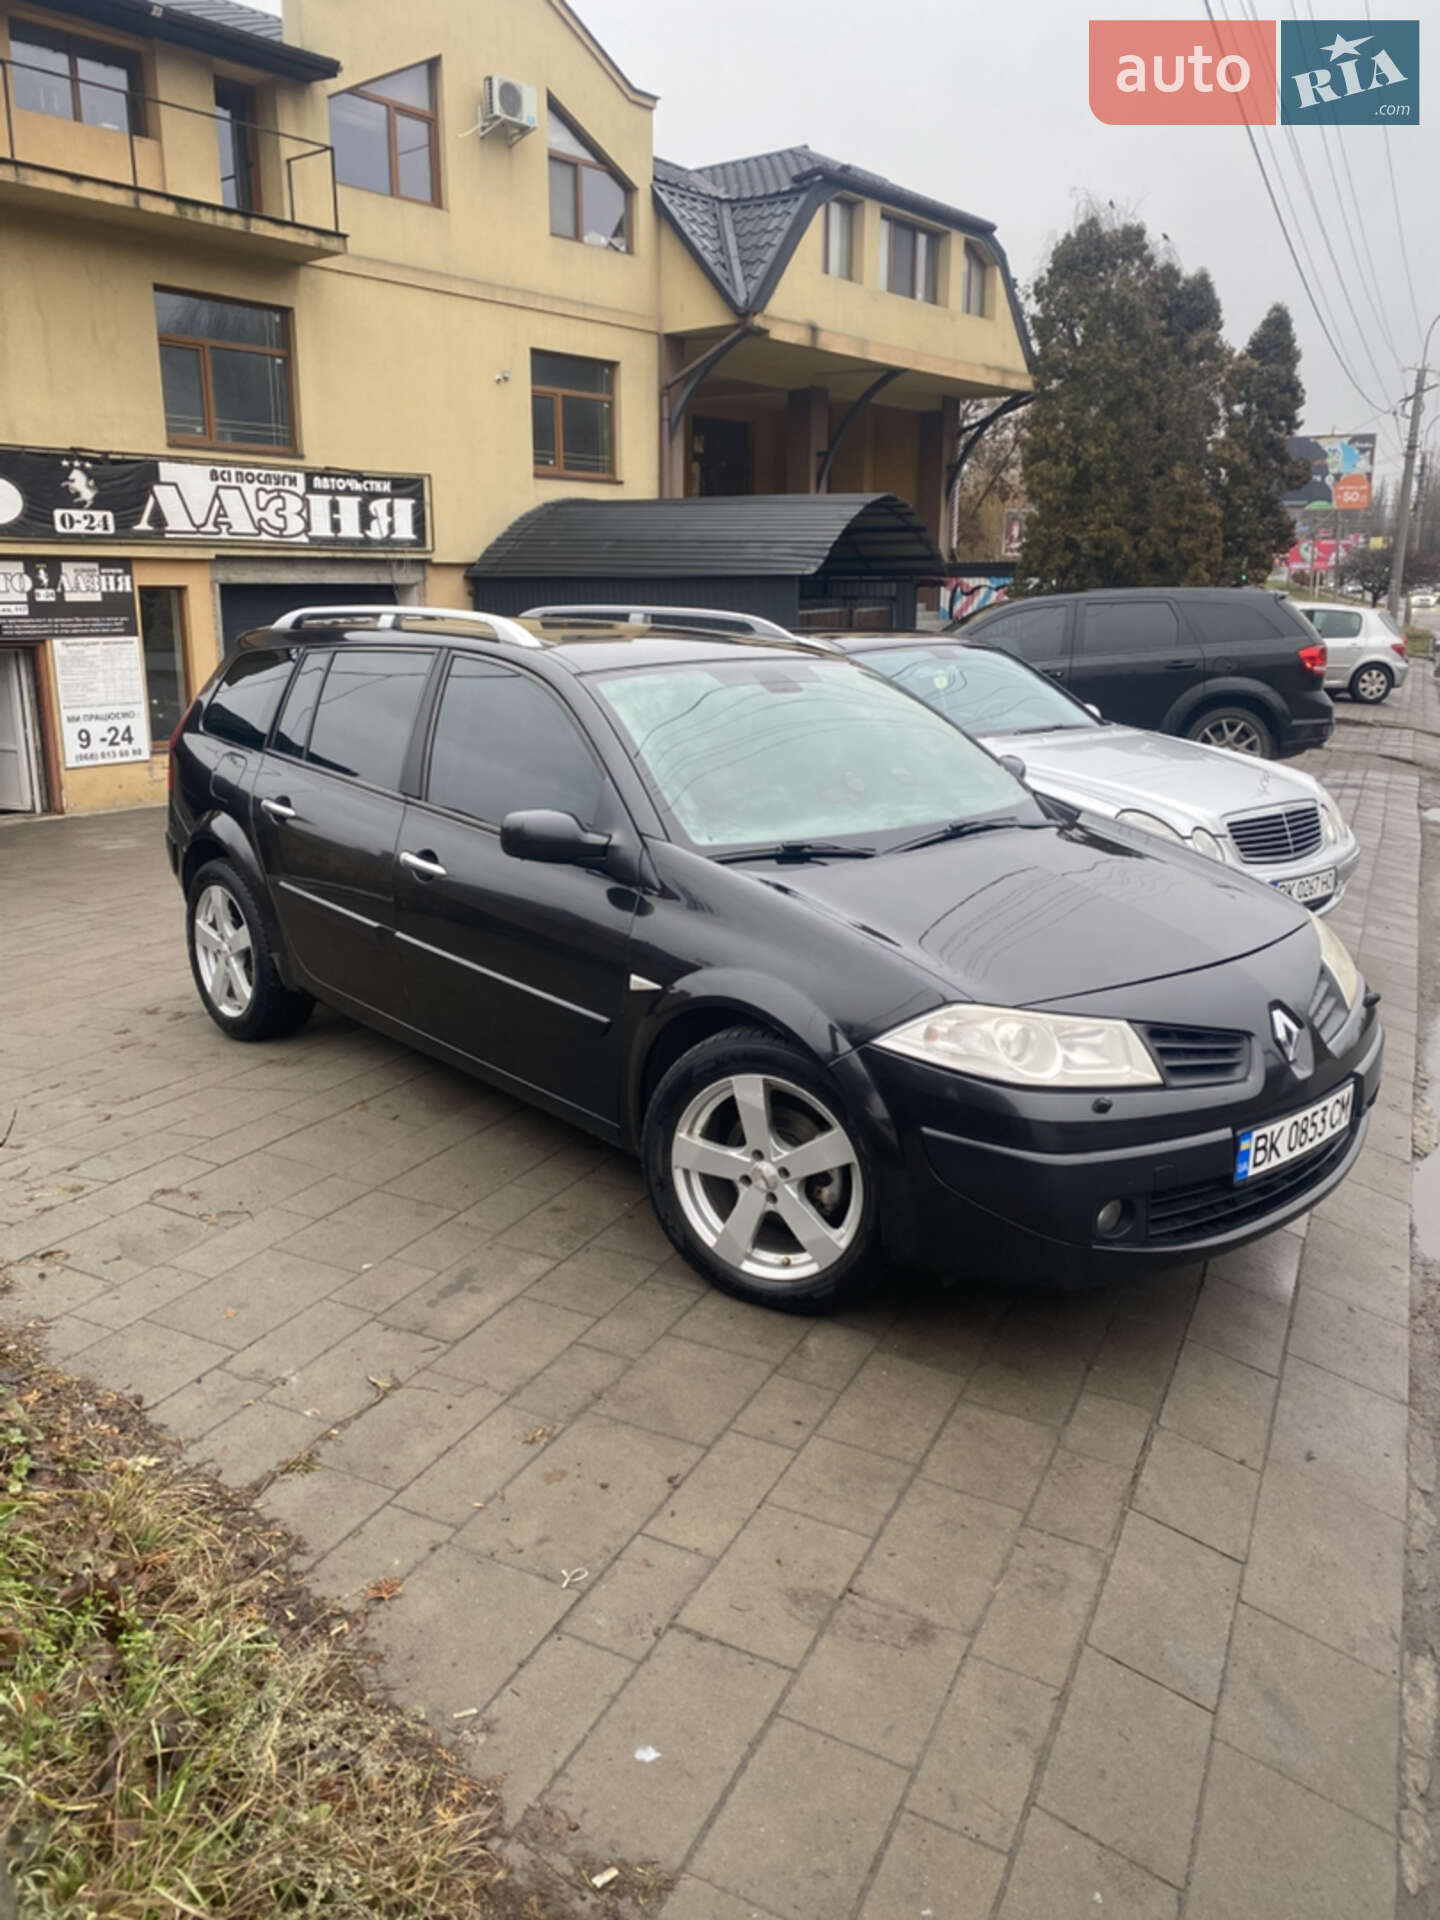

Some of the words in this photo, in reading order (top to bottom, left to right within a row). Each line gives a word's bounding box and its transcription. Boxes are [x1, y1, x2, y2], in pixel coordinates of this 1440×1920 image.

[209, 468, 233, 482] ВСІ
[235, 469, 298, 488] ПОСЛУГИ
[60, 511, 110, 531] 0-24
[131, 482, 418, 540] ЛАЗНЯ
[56, 572, 133, 593] ЛАЗНЯ
[77, 728, 91, 749] 9
[1252, 1126, 1285, 1169] BK
[1286, 1104, 1328, 1152] 0853
[1328, 1091, 1351, 1131] CM
